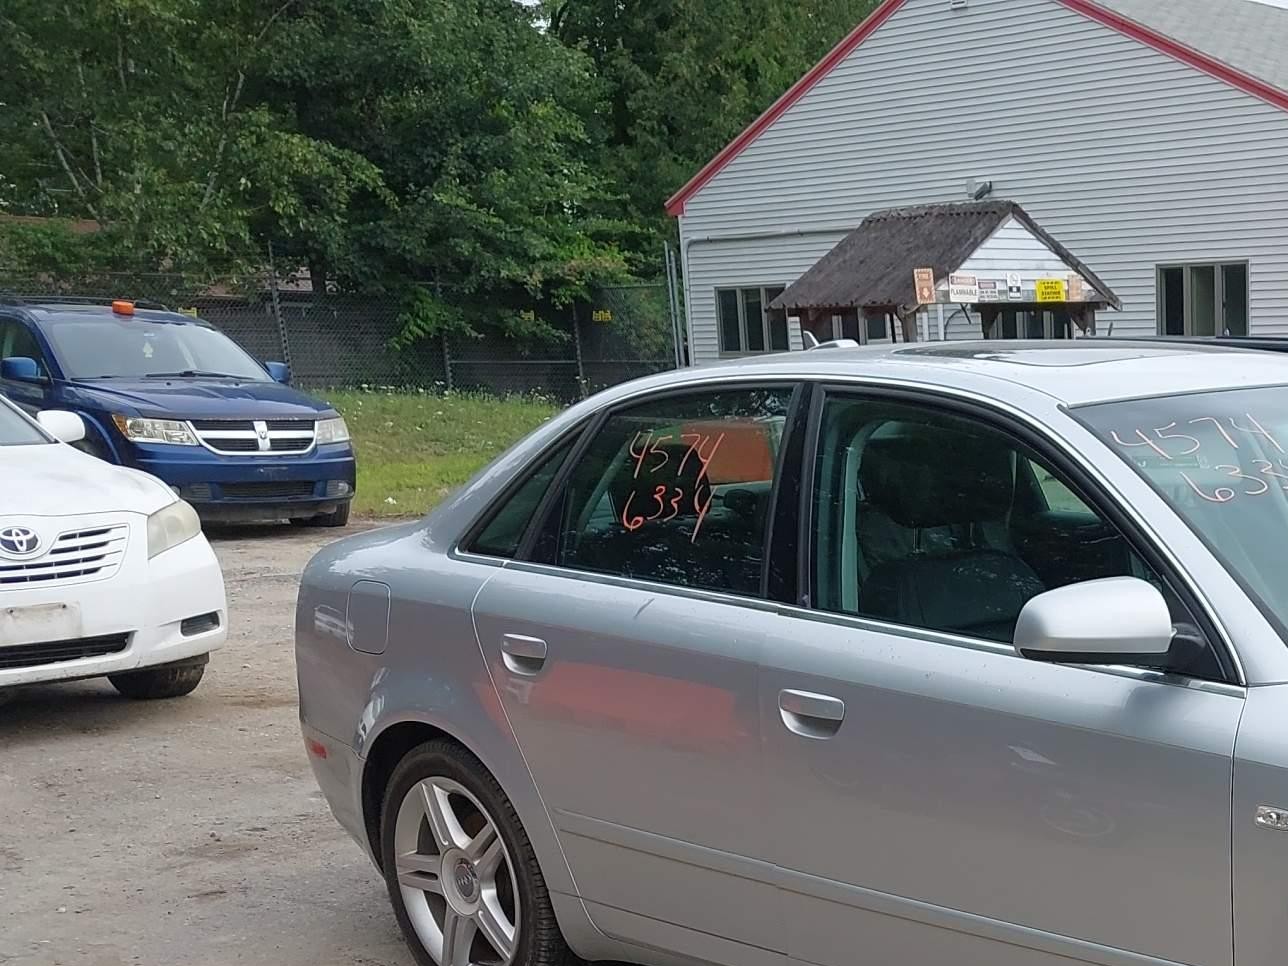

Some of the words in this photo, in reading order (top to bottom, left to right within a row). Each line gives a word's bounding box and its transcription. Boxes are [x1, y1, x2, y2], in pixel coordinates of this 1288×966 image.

[629, 429, 725, 489] 4574
[1110, 413, 1286, 460] 4574
[622, 484, 717, 543] 6334
